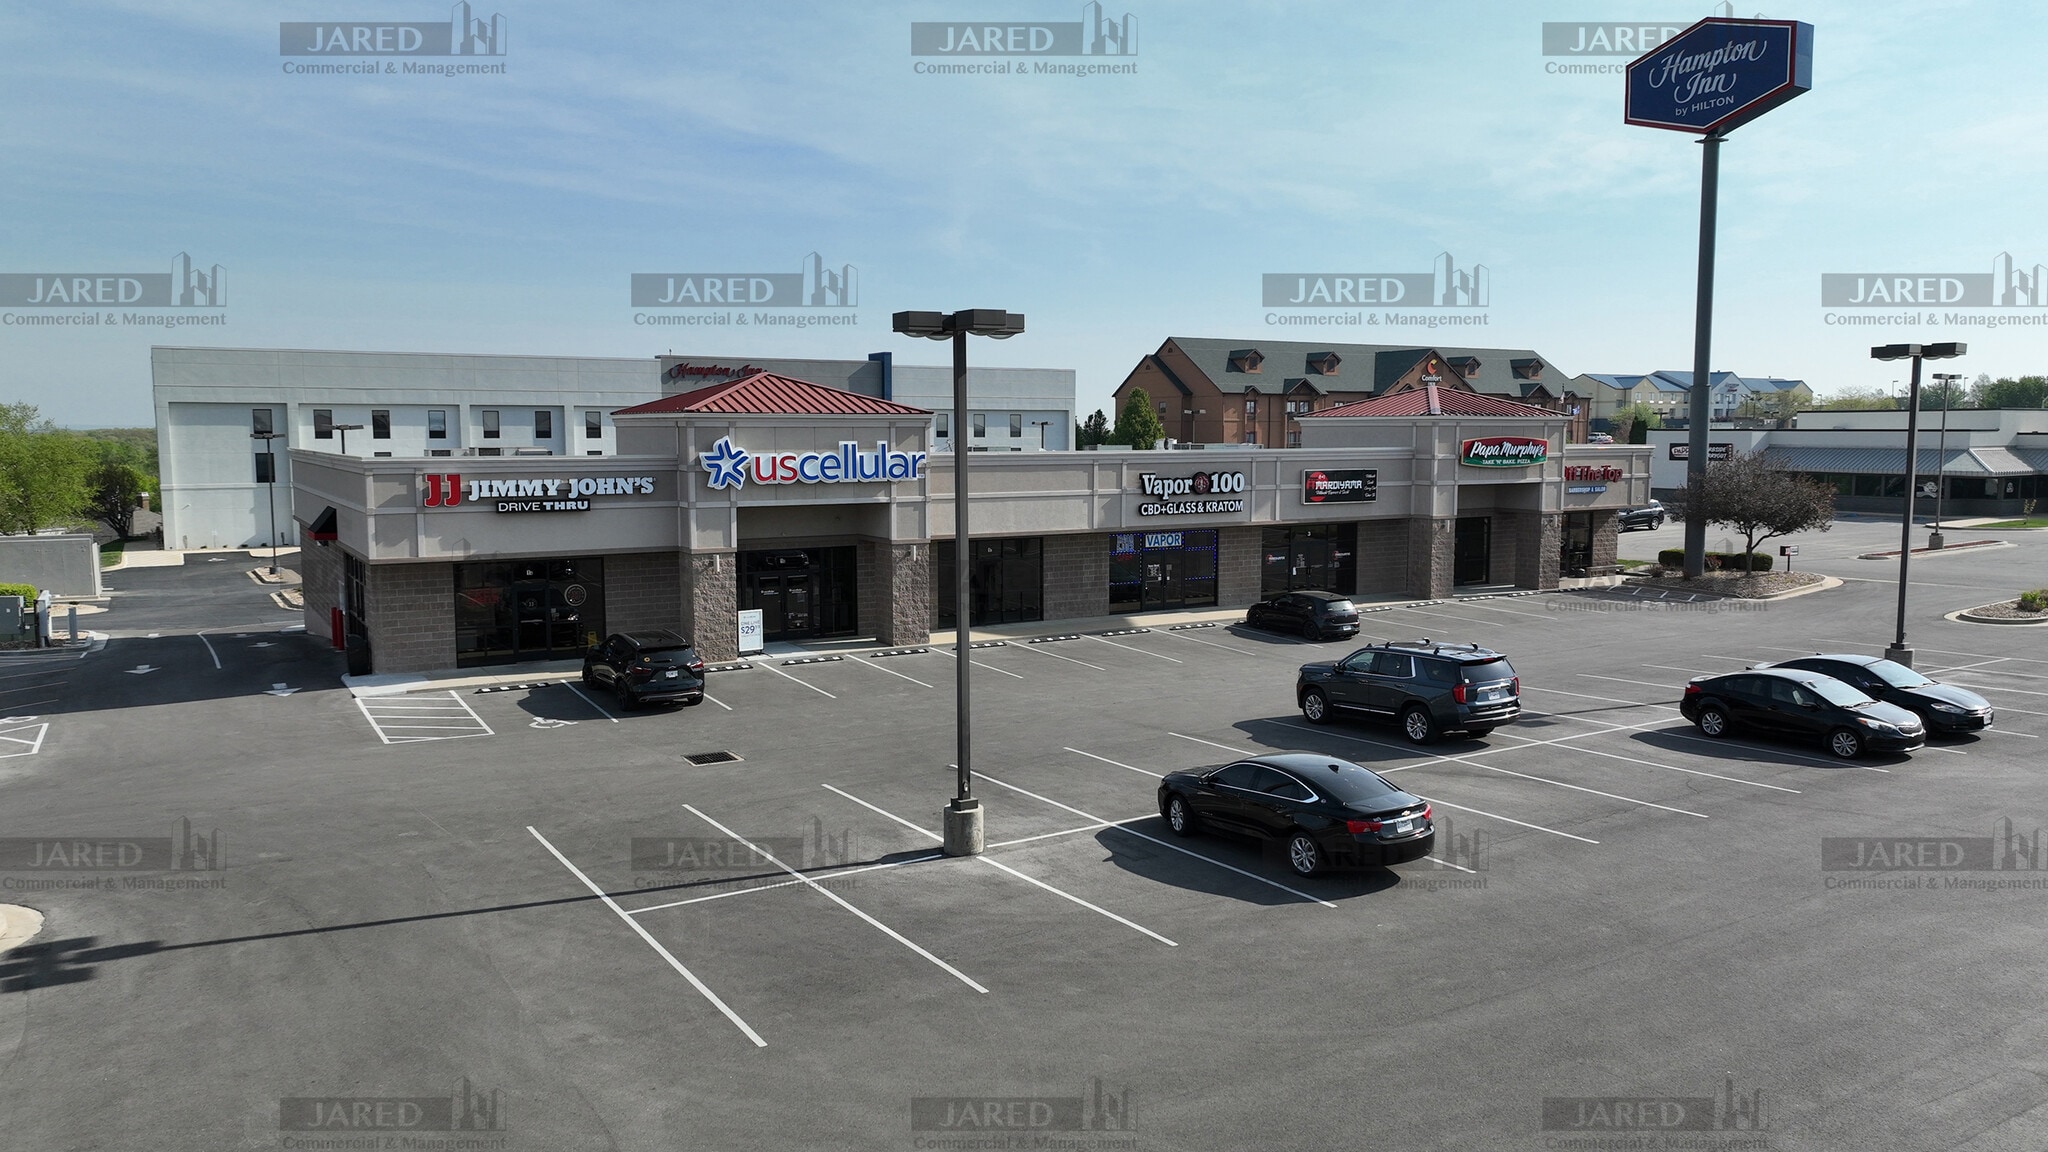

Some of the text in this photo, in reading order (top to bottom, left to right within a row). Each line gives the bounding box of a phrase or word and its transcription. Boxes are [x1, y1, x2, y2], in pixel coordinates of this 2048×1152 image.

[1649, 40, 1766, 88] Hampton
[1674, 71, 1737, 104] Inn
[1675, 95, 1734, 116] by HILTON
[670, 363, 735, 378] Hampton
[1422, 374, 1442, 382] Comfort
[1470, 441, 1545, 458] Papa Murphy's
[754, 442, 926, 482] uscellular
[1601, 465, 1622, 482] Top
[424, 474, 461, 507] JJ
[469, 478, 654, 500] JIMMY JOHN'S
[1142, 473, 1244, 500] Vapor 100
[498, 500, 588, 512] DRIVE THRU
[1142, 501, 1244, 516] CBD+GLASS & KRATOM
[1146, 534, 1180, 547] VAPOR
